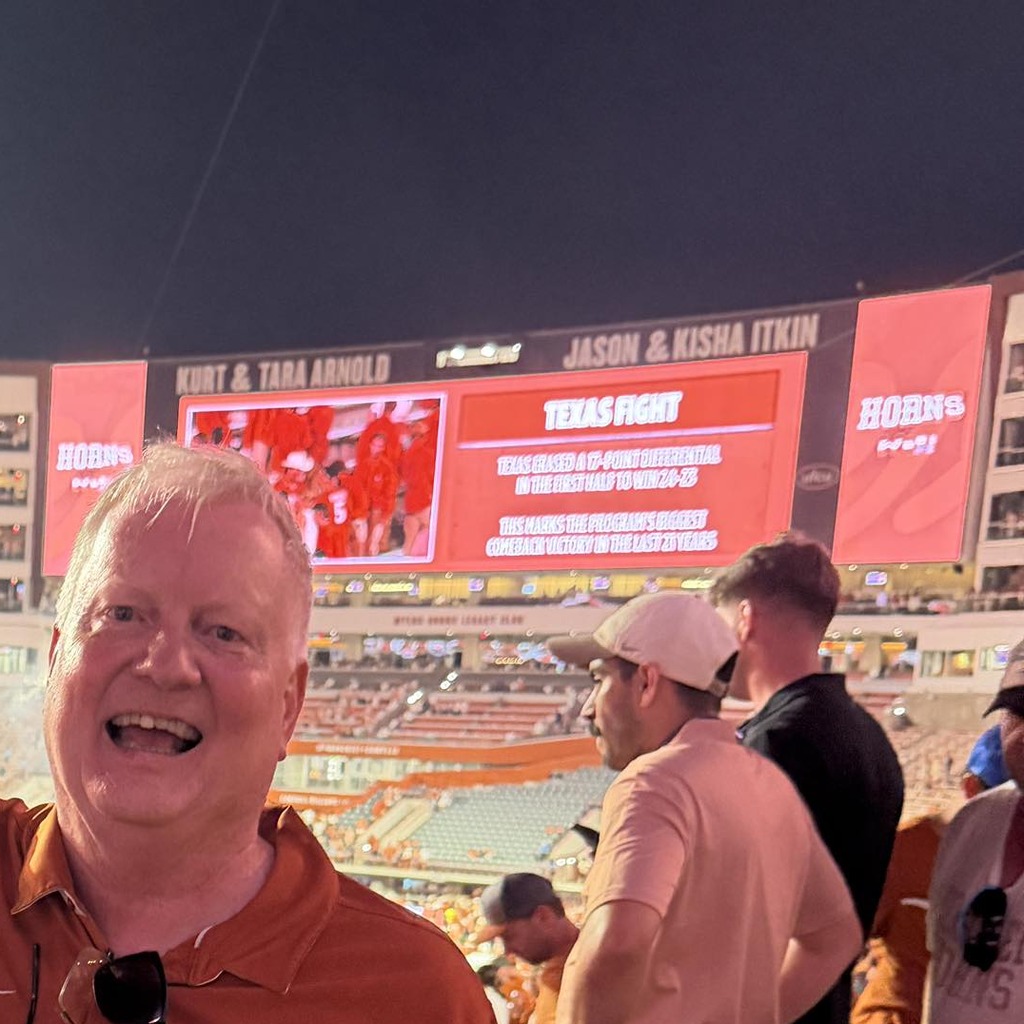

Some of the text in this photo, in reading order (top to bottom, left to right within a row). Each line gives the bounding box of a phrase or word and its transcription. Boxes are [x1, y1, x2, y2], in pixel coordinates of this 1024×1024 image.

[563, 313, 820, 369] JASON & KISHA ITKIN
[176, 353, 391, 394] KURT & TARA ARNOLD
[544, 391, 683, 430] TEXAS FIGHT
[856, 393, 965, 431] HORNS
[56, 442, 133, 471] HORNS
[497, 444, 722, 475] TEXAS ERASED A 17-POINT DIFFERENTIAL
[515, 475, 530, 495] IN
[530, 474, 553, 495] THE
[553, 472, 584, 494] FIRST
[584, 470, 615, 492] HALF
[616, 470, 632, 490] TO
[633, 468, 658, 490] WIN
[499, 508, 709, 535] THIS MARKS THE PROGRAM'S BIGGEST
[486, 536, 546, 557] COMEBACK
[546, 535, 594, 555] VICTORY
[593, 534, 610, 553] IN
[610, 533, 633, 553] THE
[633, 531, 662, 552] LAST
[677, 529, 718, 551] YEARS
